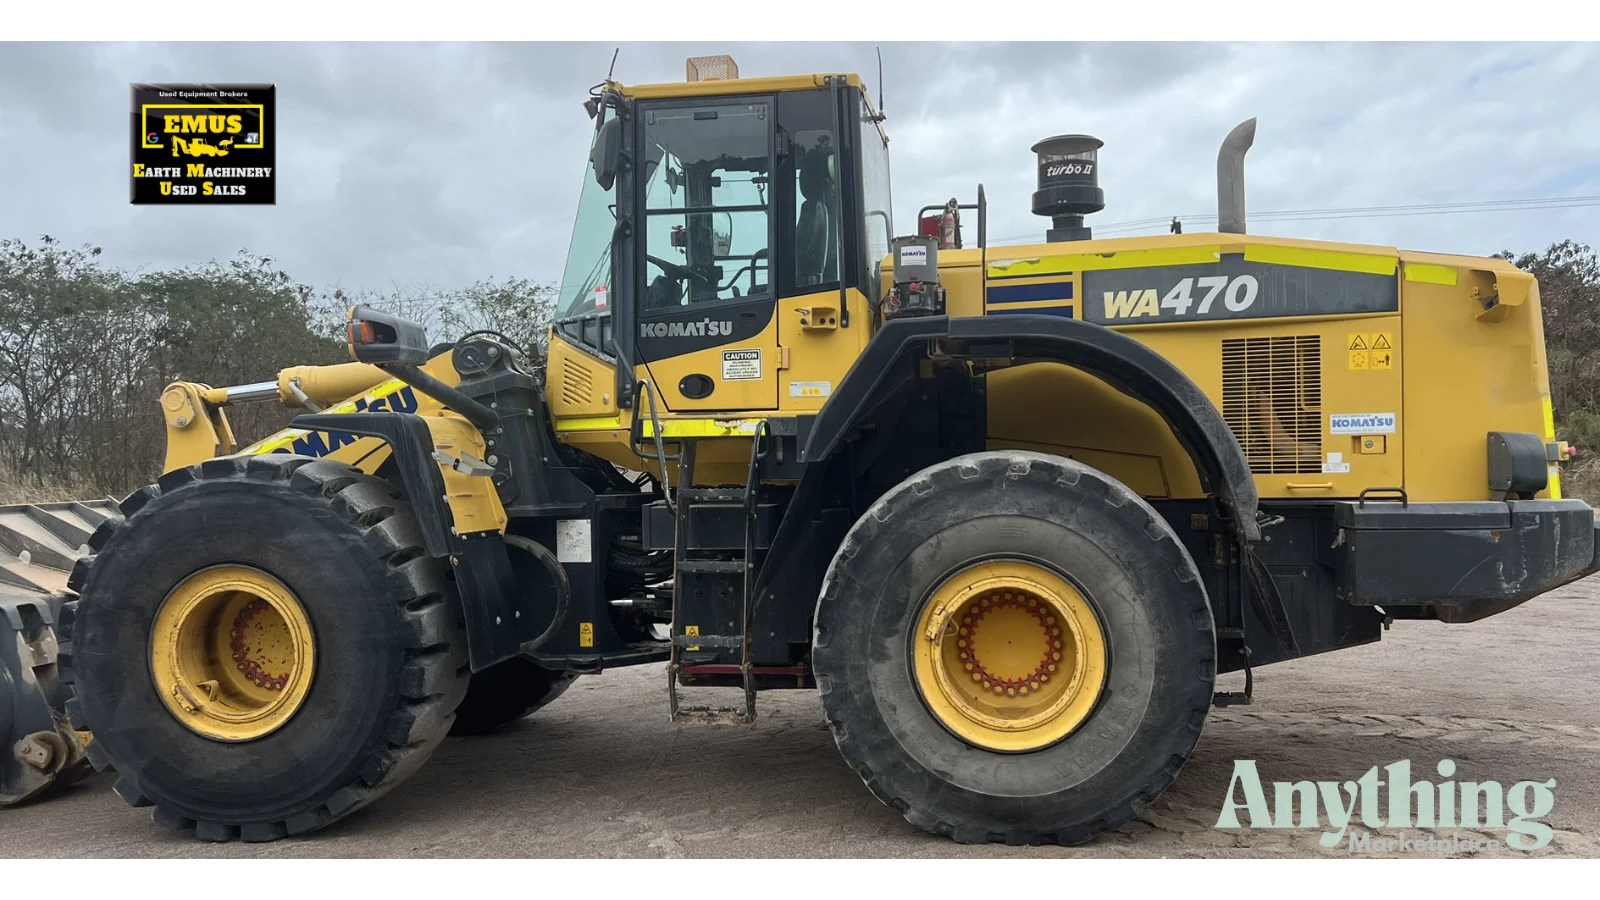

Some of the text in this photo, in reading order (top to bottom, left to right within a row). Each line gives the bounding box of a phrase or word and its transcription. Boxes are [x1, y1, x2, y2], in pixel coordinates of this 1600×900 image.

[1047, 164, 1081, 176] turbo
[1103, 275, 1259, 319] WA470
[640, 318, 733, 338] KOMATSU
[725, 352, 758, 360] CAUTION
[1332, 416, 1393, 427] KOMATSU
